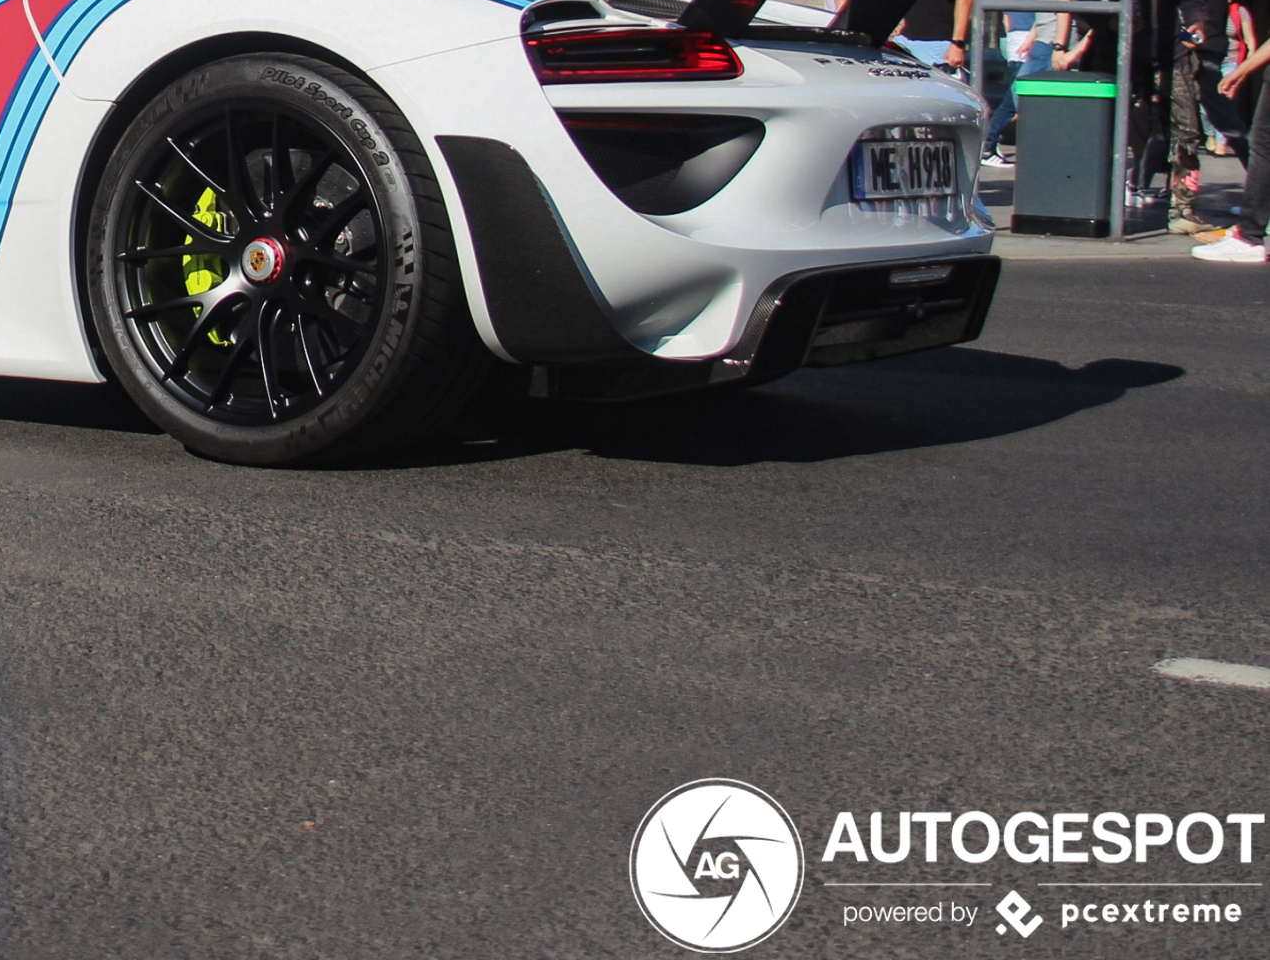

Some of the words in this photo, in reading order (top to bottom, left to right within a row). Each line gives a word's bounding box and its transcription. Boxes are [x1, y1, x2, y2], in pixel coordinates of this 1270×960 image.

[260, 66, 306, 89] Pilot
[303, 82, 353, 120] Sport
[350, 118, 377, 151] Cup
[373, 151, 390, 167] 2
[870, 147, 901, 191] ME
[908, 145, 922, 190] H
[923, 145, 952, 190] 918
